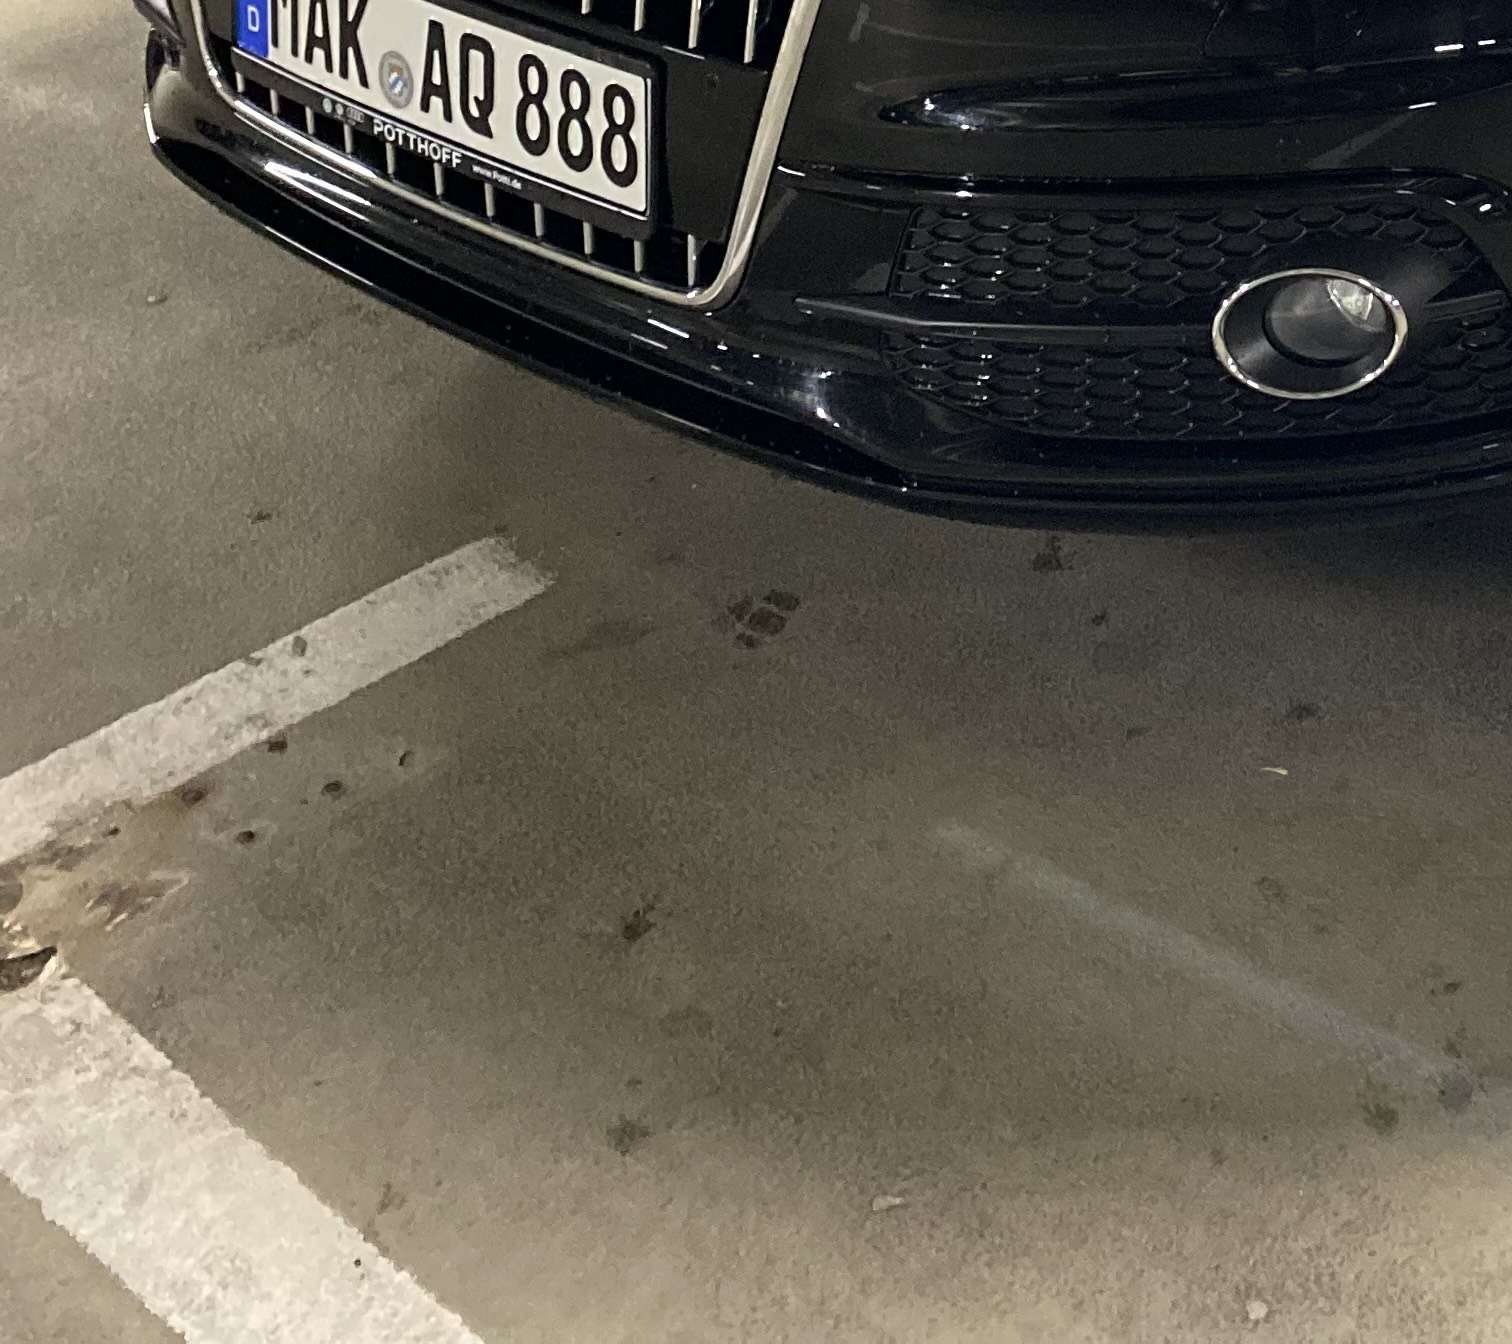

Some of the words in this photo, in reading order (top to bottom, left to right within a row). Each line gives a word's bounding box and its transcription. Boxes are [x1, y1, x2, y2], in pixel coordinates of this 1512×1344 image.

[247, 4, 260, 33] D
[420, 19, 495, 140] AQ
[515, 53, 638, 189] 888
[372, 119, 463, 170] POTTHOFF
